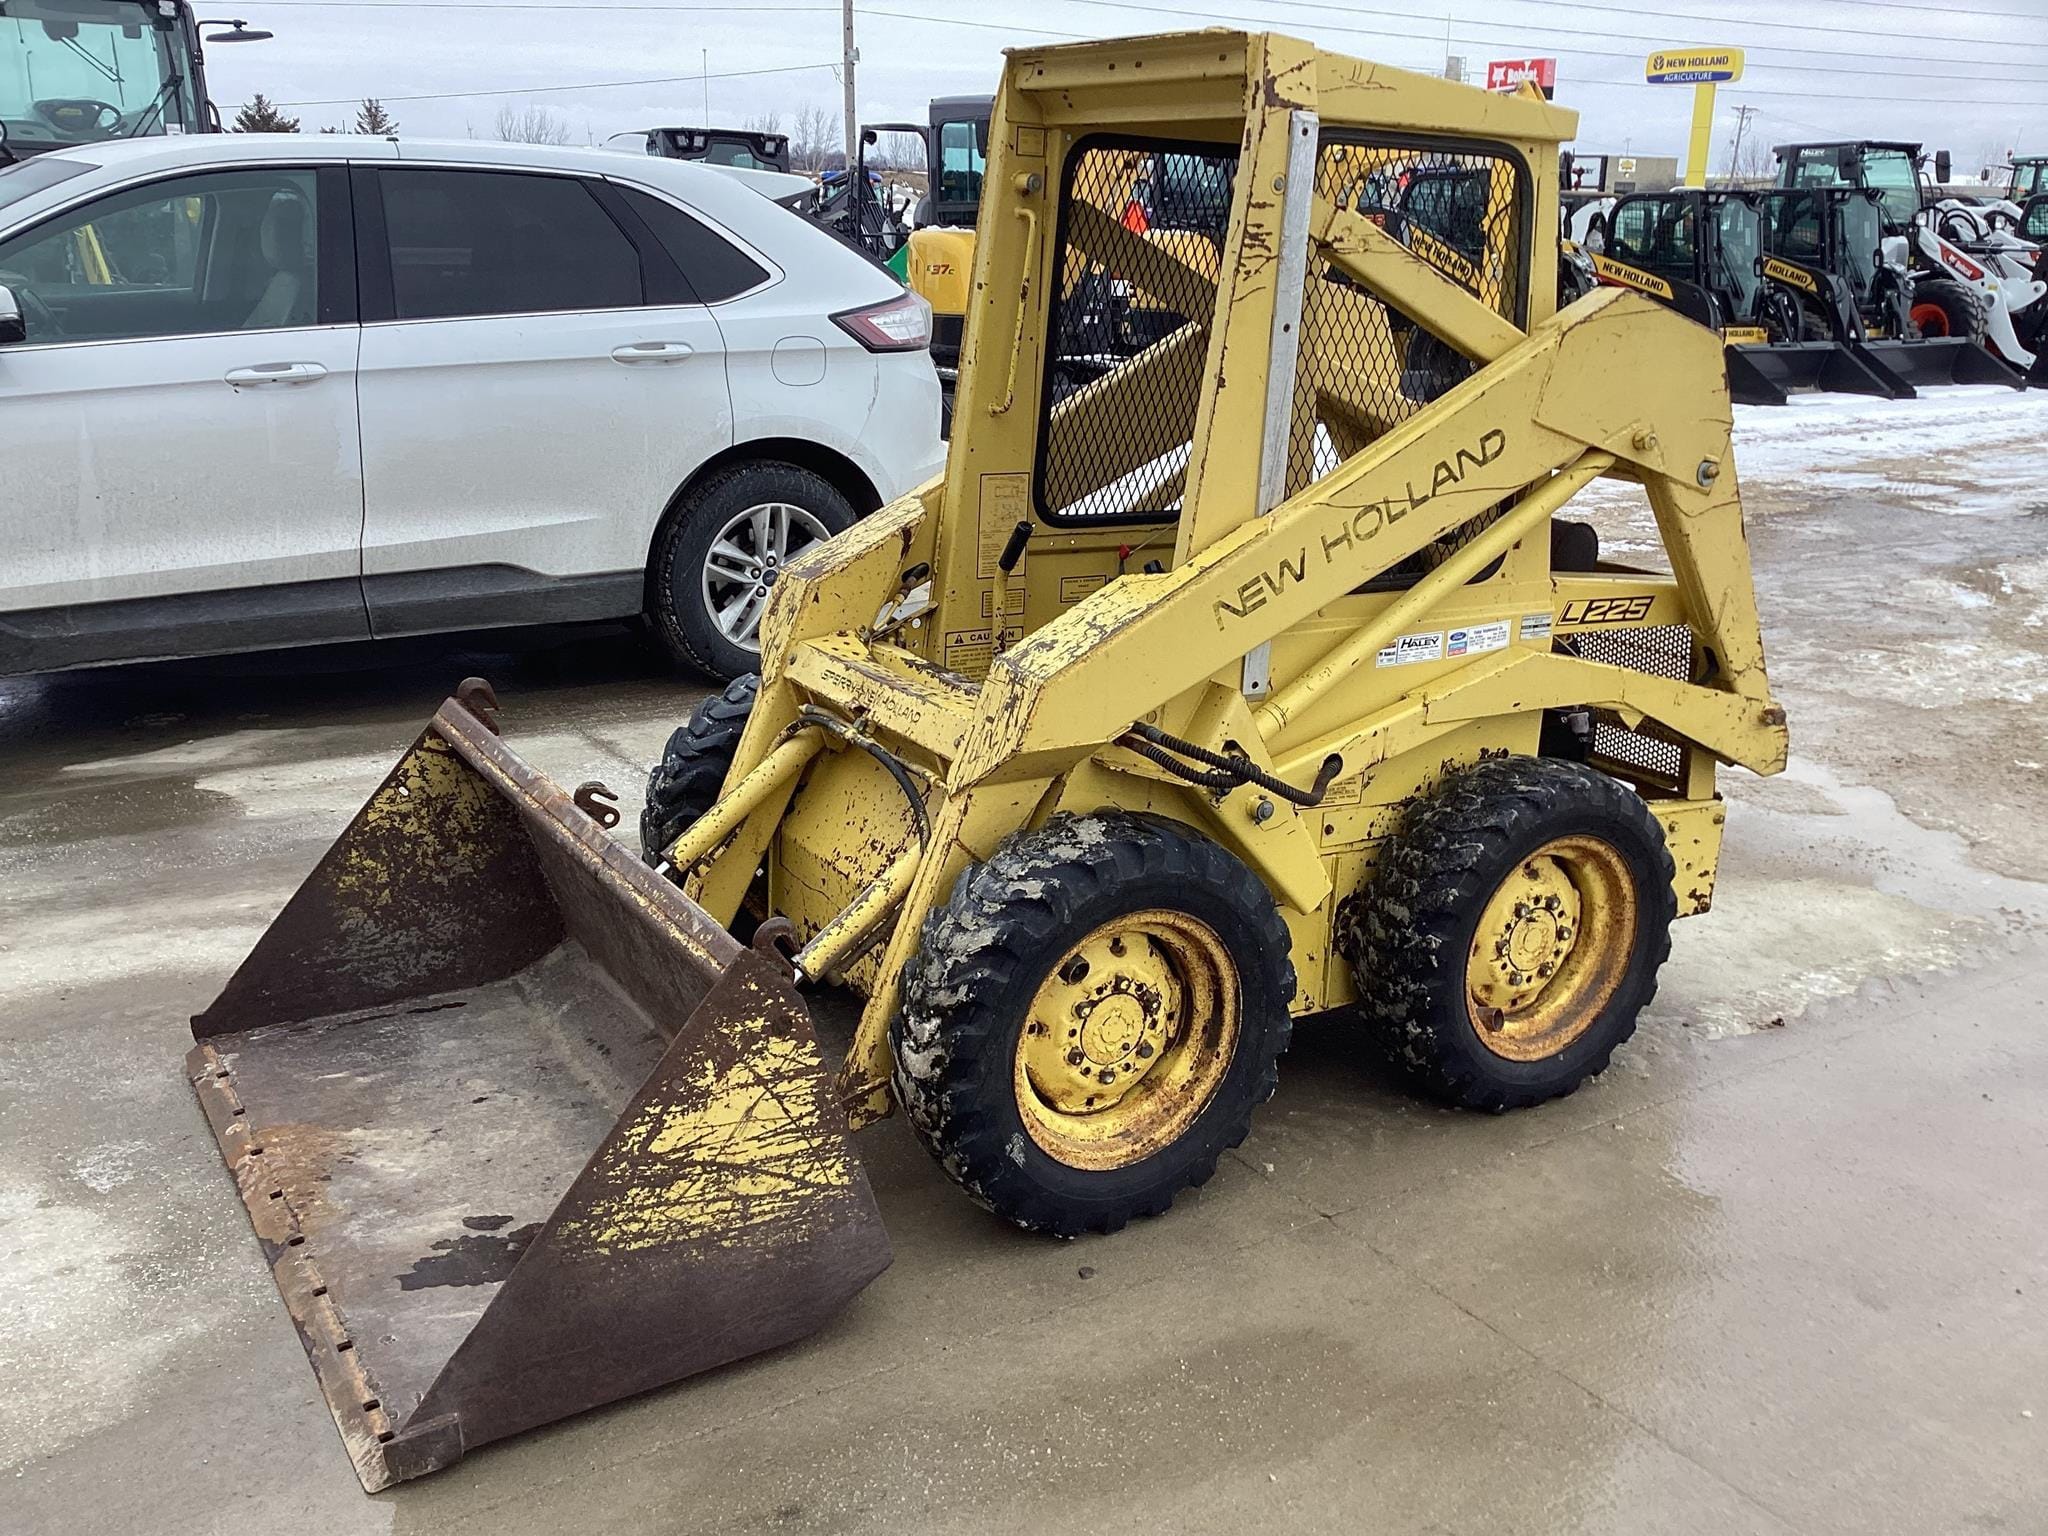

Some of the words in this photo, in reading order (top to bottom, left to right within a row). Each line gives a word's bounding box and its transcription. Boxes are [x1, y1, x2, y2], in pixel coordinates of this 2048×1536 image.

[1666, 58, 1687, 68] NEW
[1688, 56, 1729, 67] HOLLAND
[1664, 72, 1713, 82] AGRICULTURE
[1602, 261, 1624, 277] NEW
[1624, 270, 1664, 292] HOLLAND
[1769, 263, 1807, 284] HOLLAND
[1212, 547, 1306, 632] NEW
[1321, 428, 1506, 564] HOLLAND
[1400, 637, 1440, 649] HALEY
